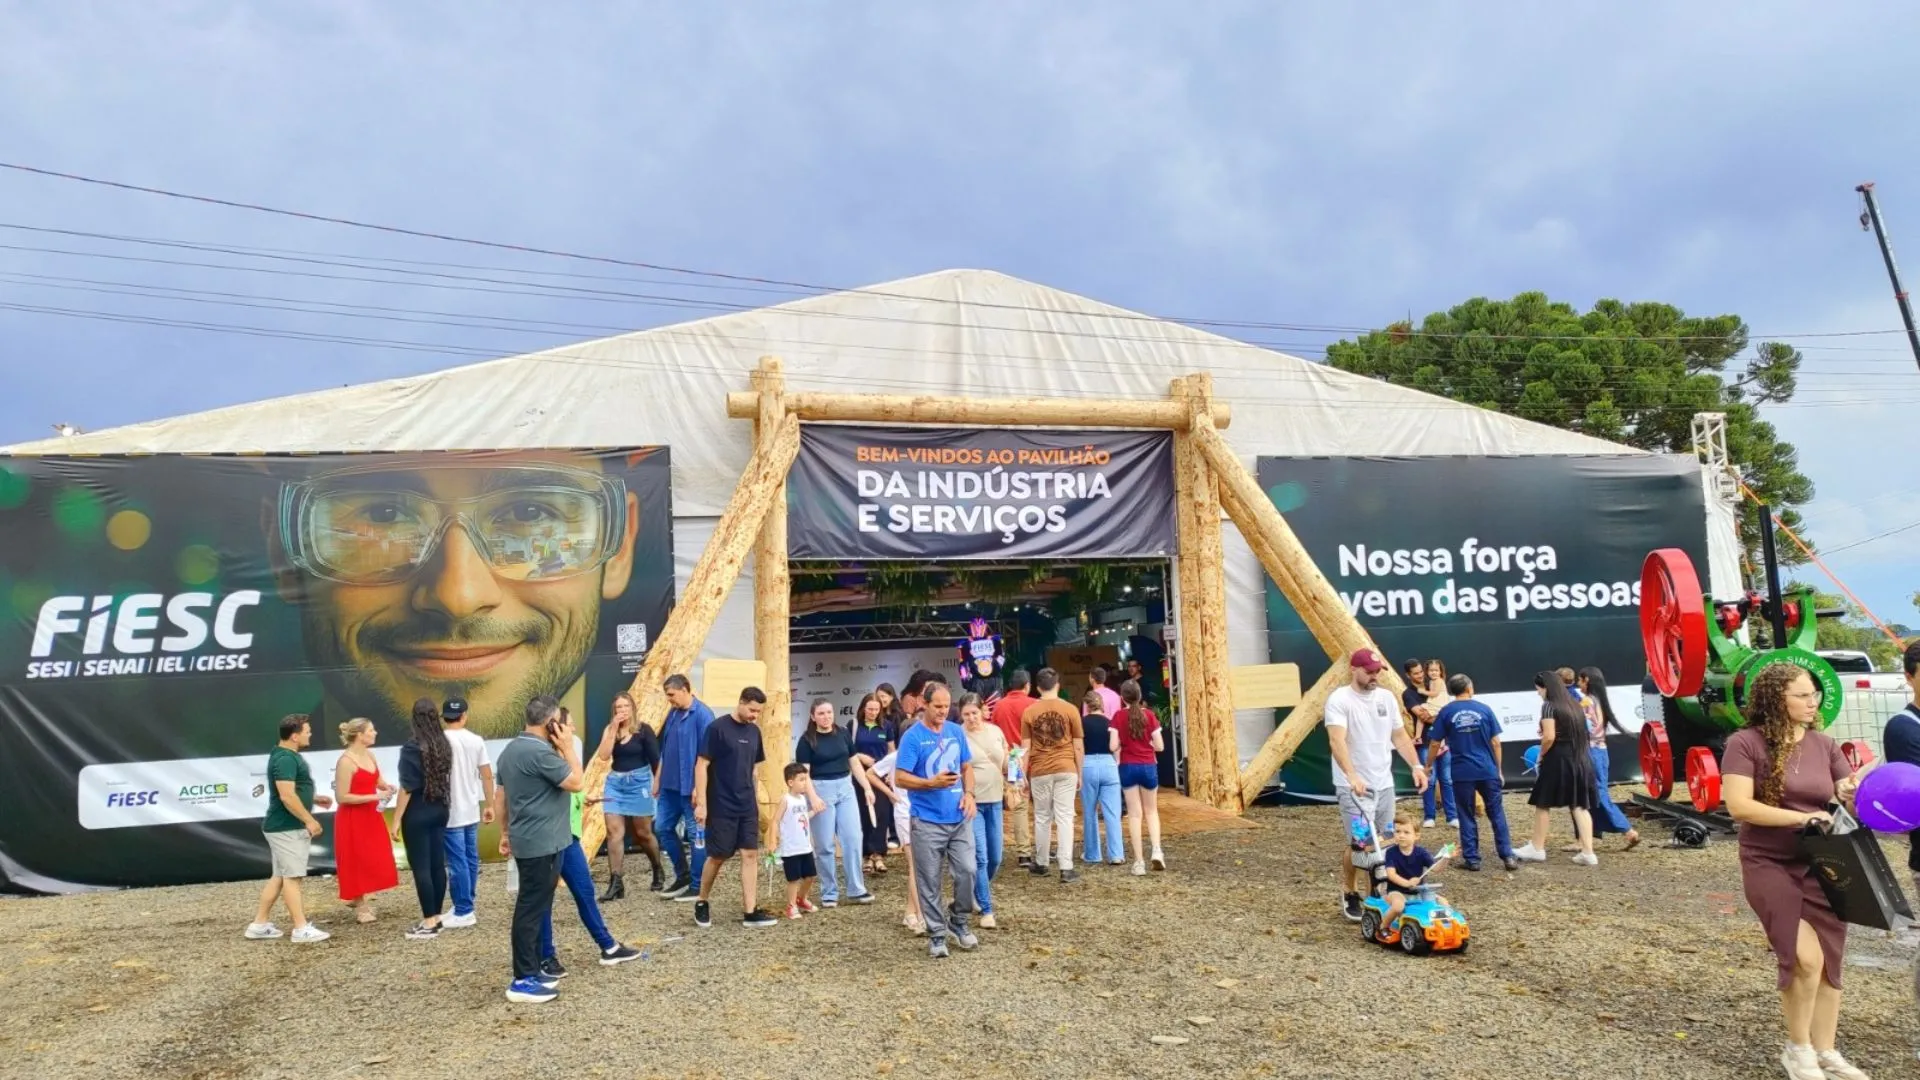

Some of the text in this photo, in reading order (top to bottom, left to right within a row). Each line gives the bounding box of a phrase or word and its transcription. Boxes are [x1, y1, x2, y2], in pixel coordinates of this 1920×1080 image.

[857, 445, 1111, 465] BEM-VINDOS AO PAVILHÃO
[857, 466, 1112, 499] DA INDÚSTRIA
[858, 504, 1067, 543] E SERVIÇOS
[1338, 538, 1557, 583] Nossa força
[1339, 579, 1642, 619] vem das pessoas
[26, 654, 250, 679] SESI SENAI IEL CIESC
[1787, 656, 1816, 669] SIMS
